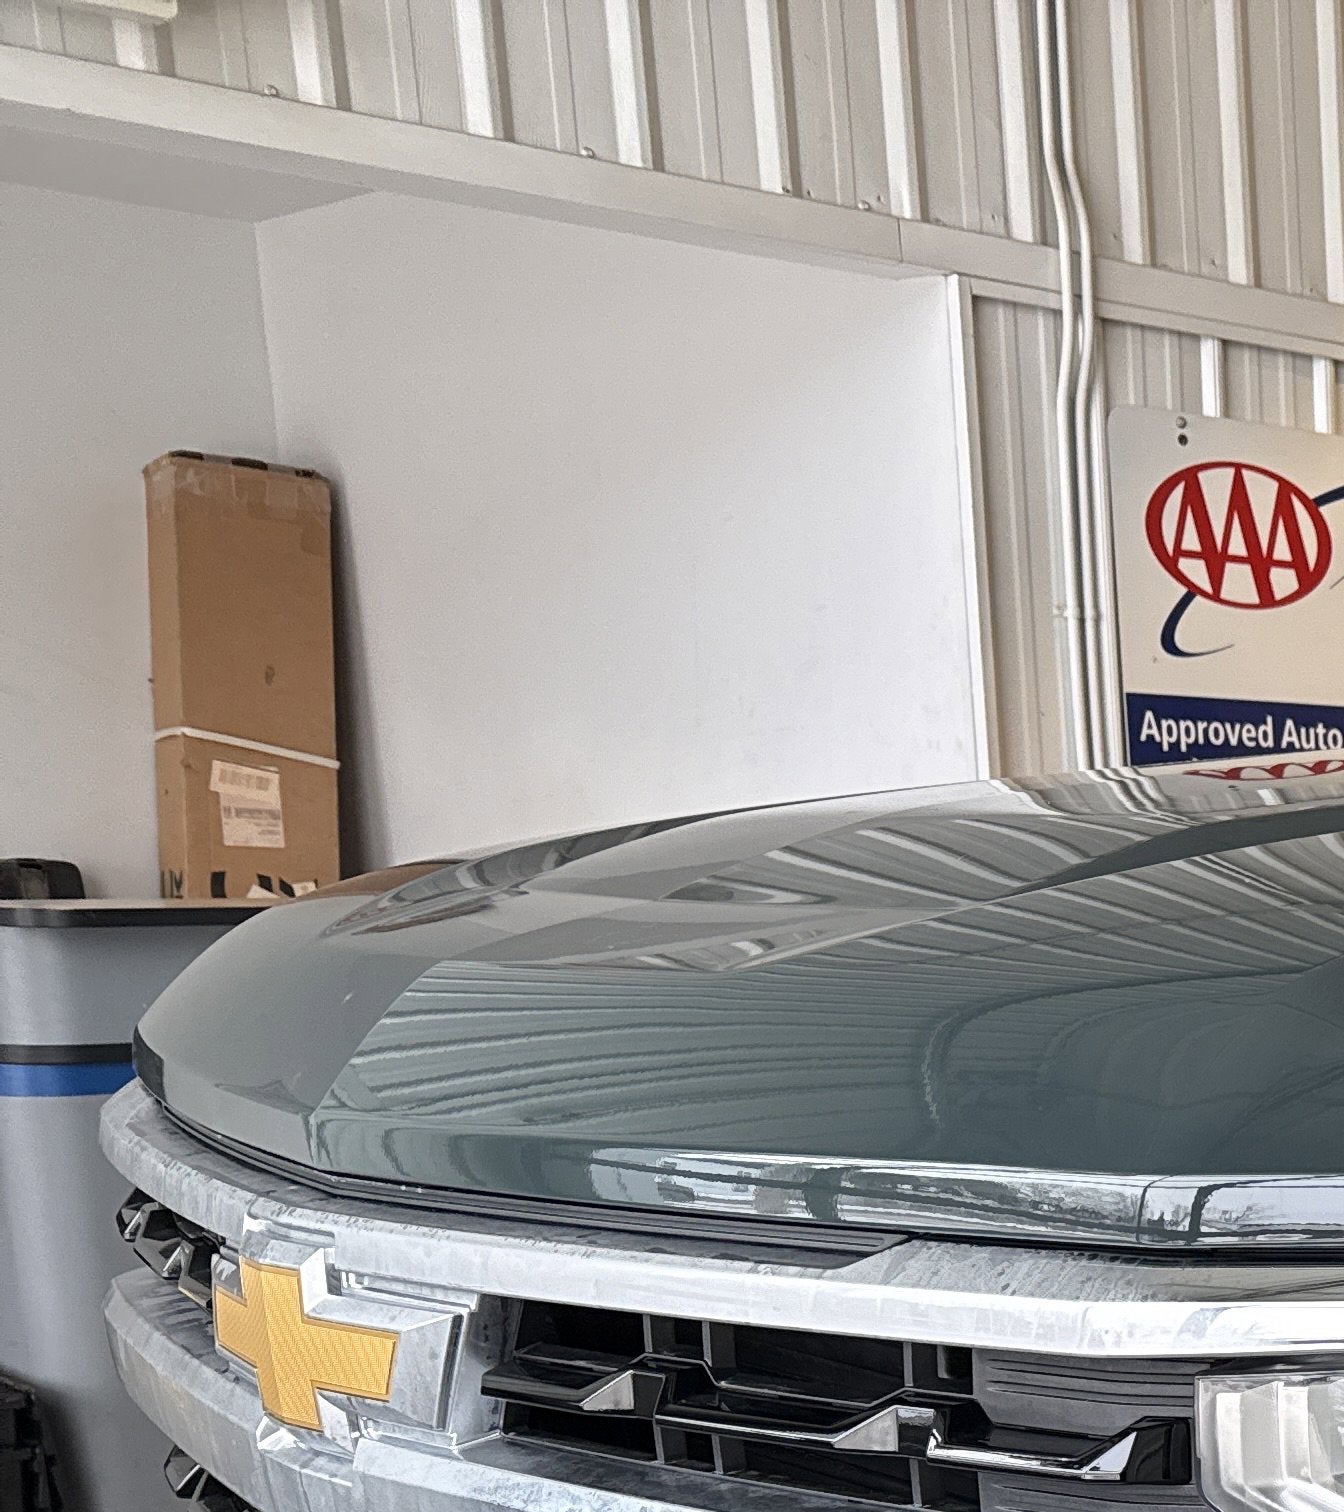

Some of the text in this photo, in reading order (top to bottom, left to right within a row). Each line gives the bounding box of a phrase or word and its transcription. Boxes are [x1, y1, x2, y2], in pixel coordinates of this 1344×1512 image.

[1160, 462, 1322, 608] AAA
[1140, 711, 1273, 755] Approved
[1281, 717, 1344, 750] Auto
